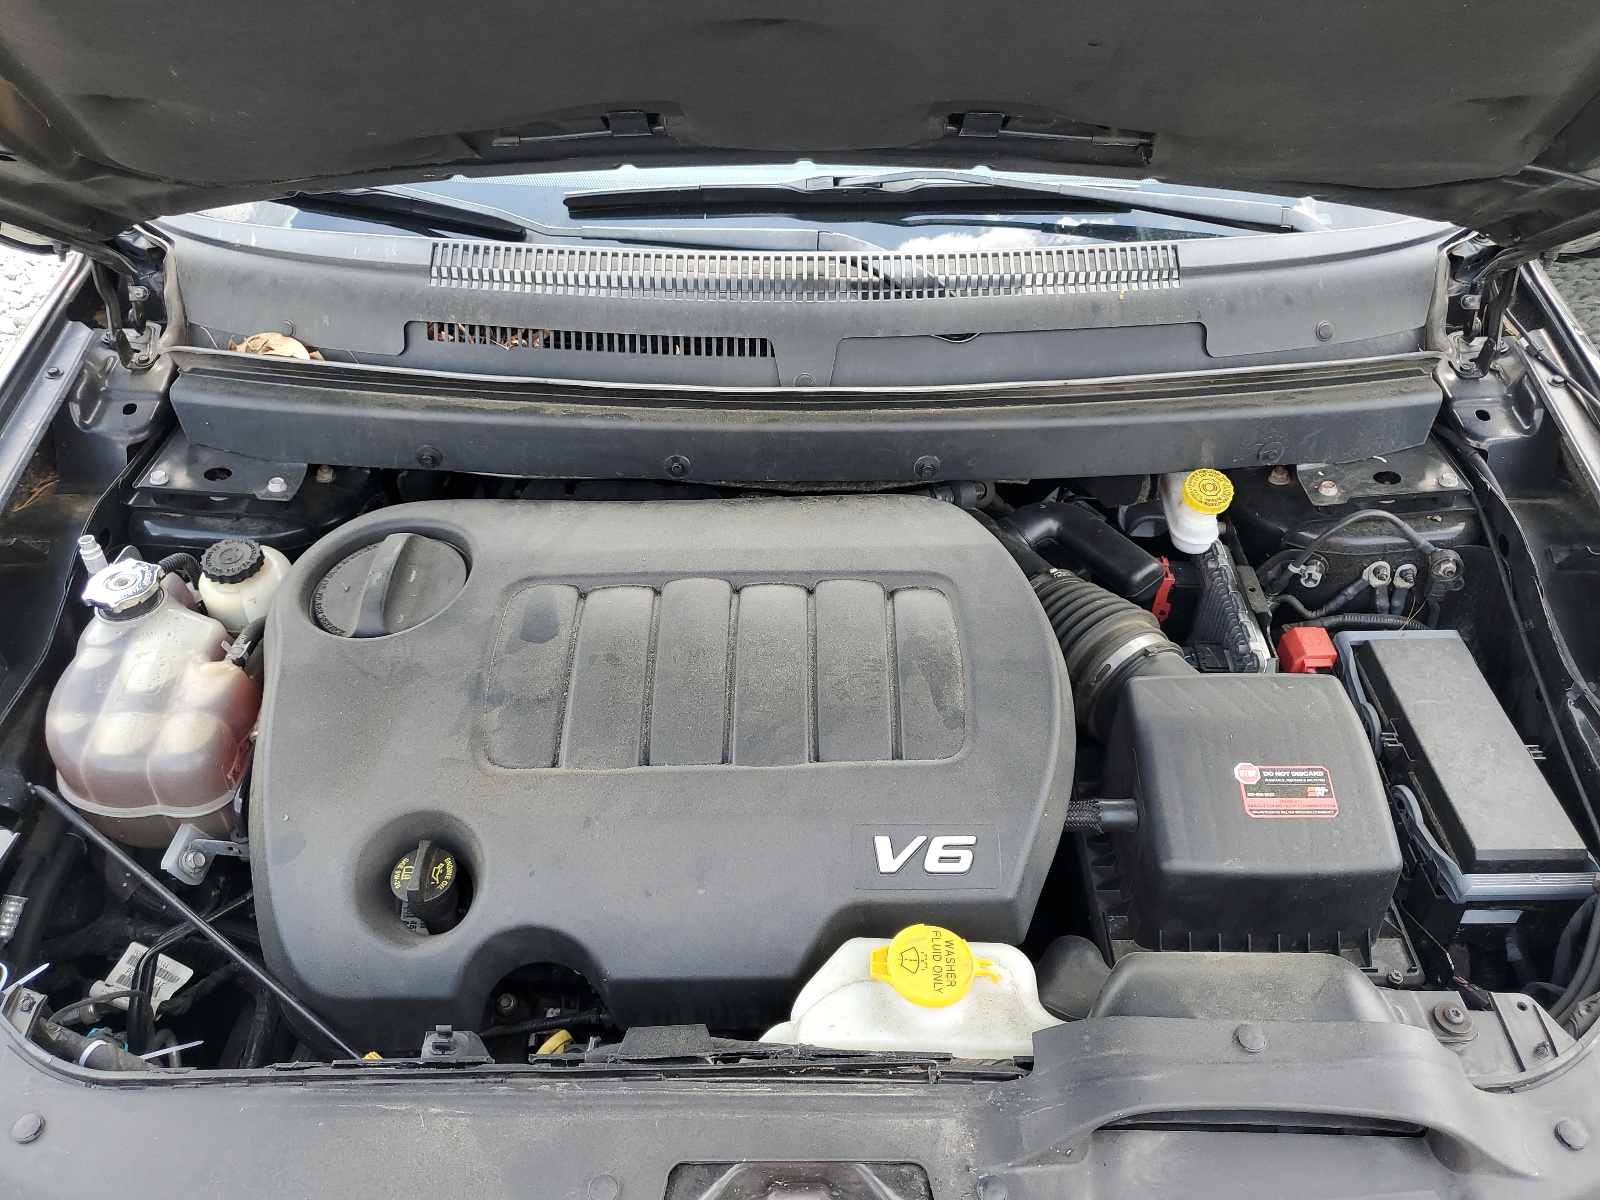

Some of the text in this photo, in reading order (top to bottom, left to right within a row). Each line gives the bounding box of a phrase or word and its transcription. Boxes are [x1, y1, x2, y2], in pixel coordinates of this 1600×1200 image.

[437, 858, 453, 889] ENGINE OIL
[873, 835, 978, 874] V6
[931, 930, 944, 994] FLUID ONLY
[944, 939, 957, 987] WASHER
